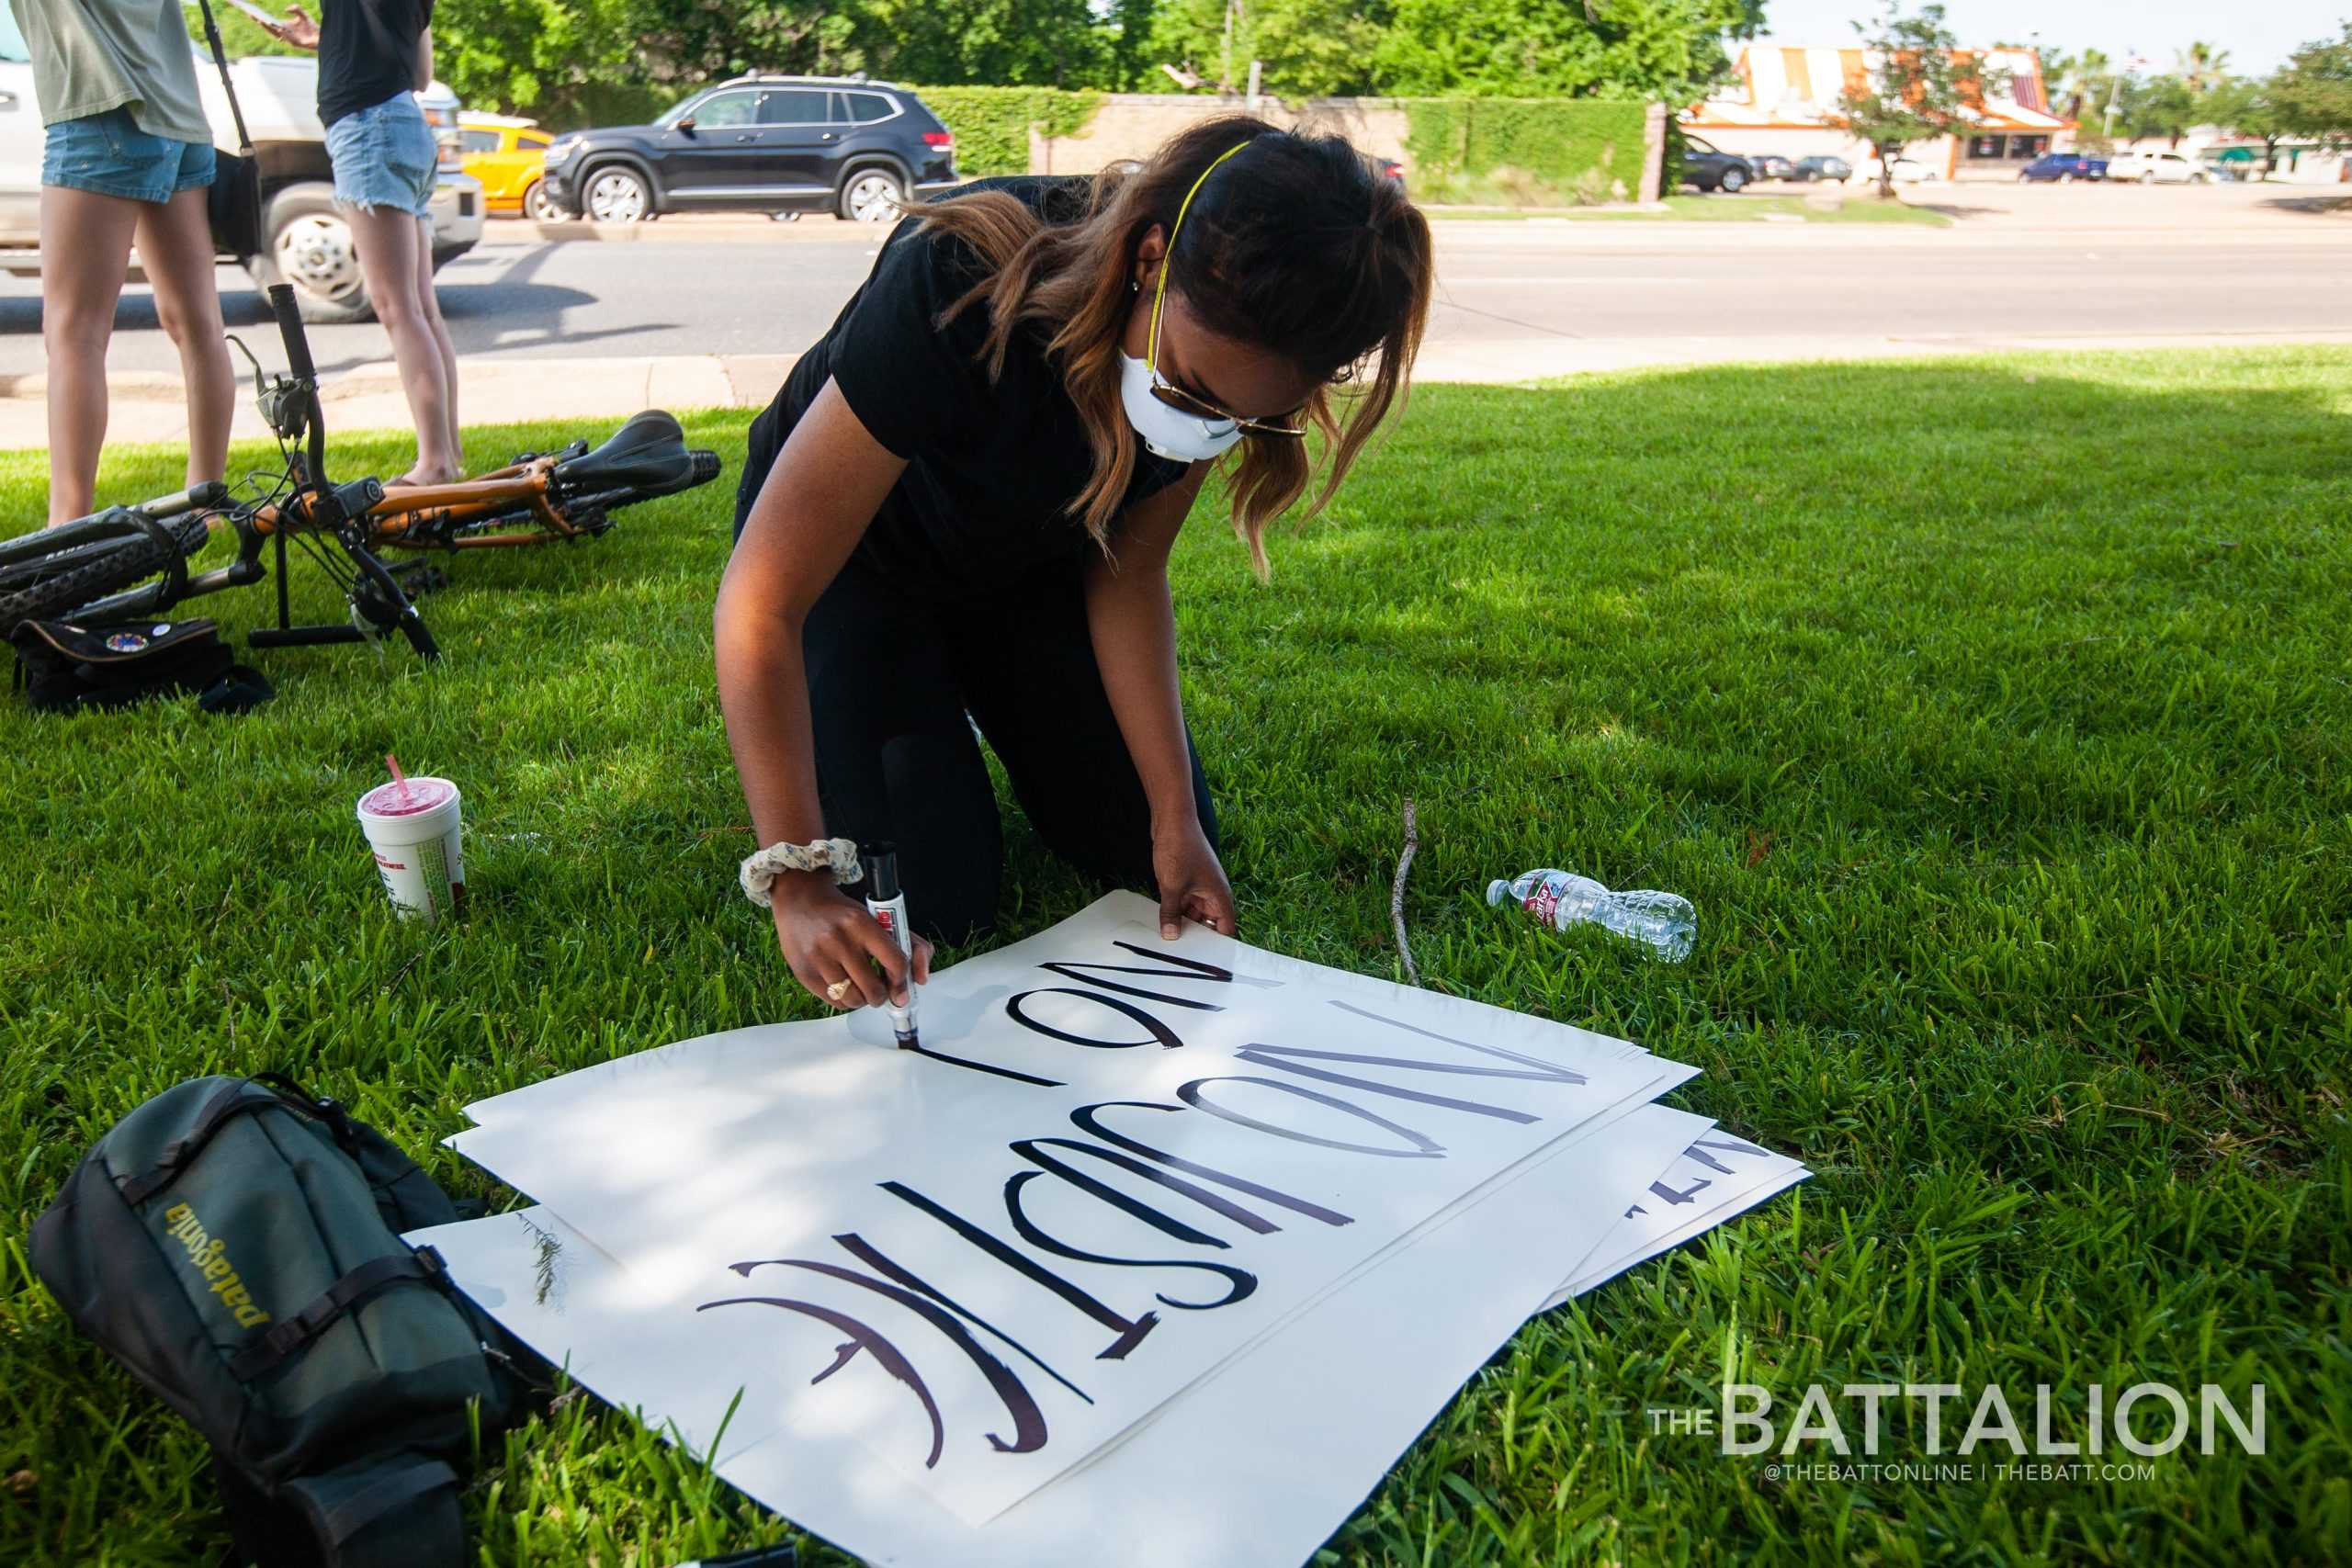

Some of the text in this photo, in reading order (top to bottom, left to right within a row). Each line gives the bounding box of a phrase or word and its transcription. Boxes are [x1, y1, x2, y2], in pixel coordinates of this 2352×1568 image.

[1005, 940, 1285, 1050] NO
[165, 1202, 270, 1327] patagonia
[696, 999, 1589, 1470] NO JUSTICE
